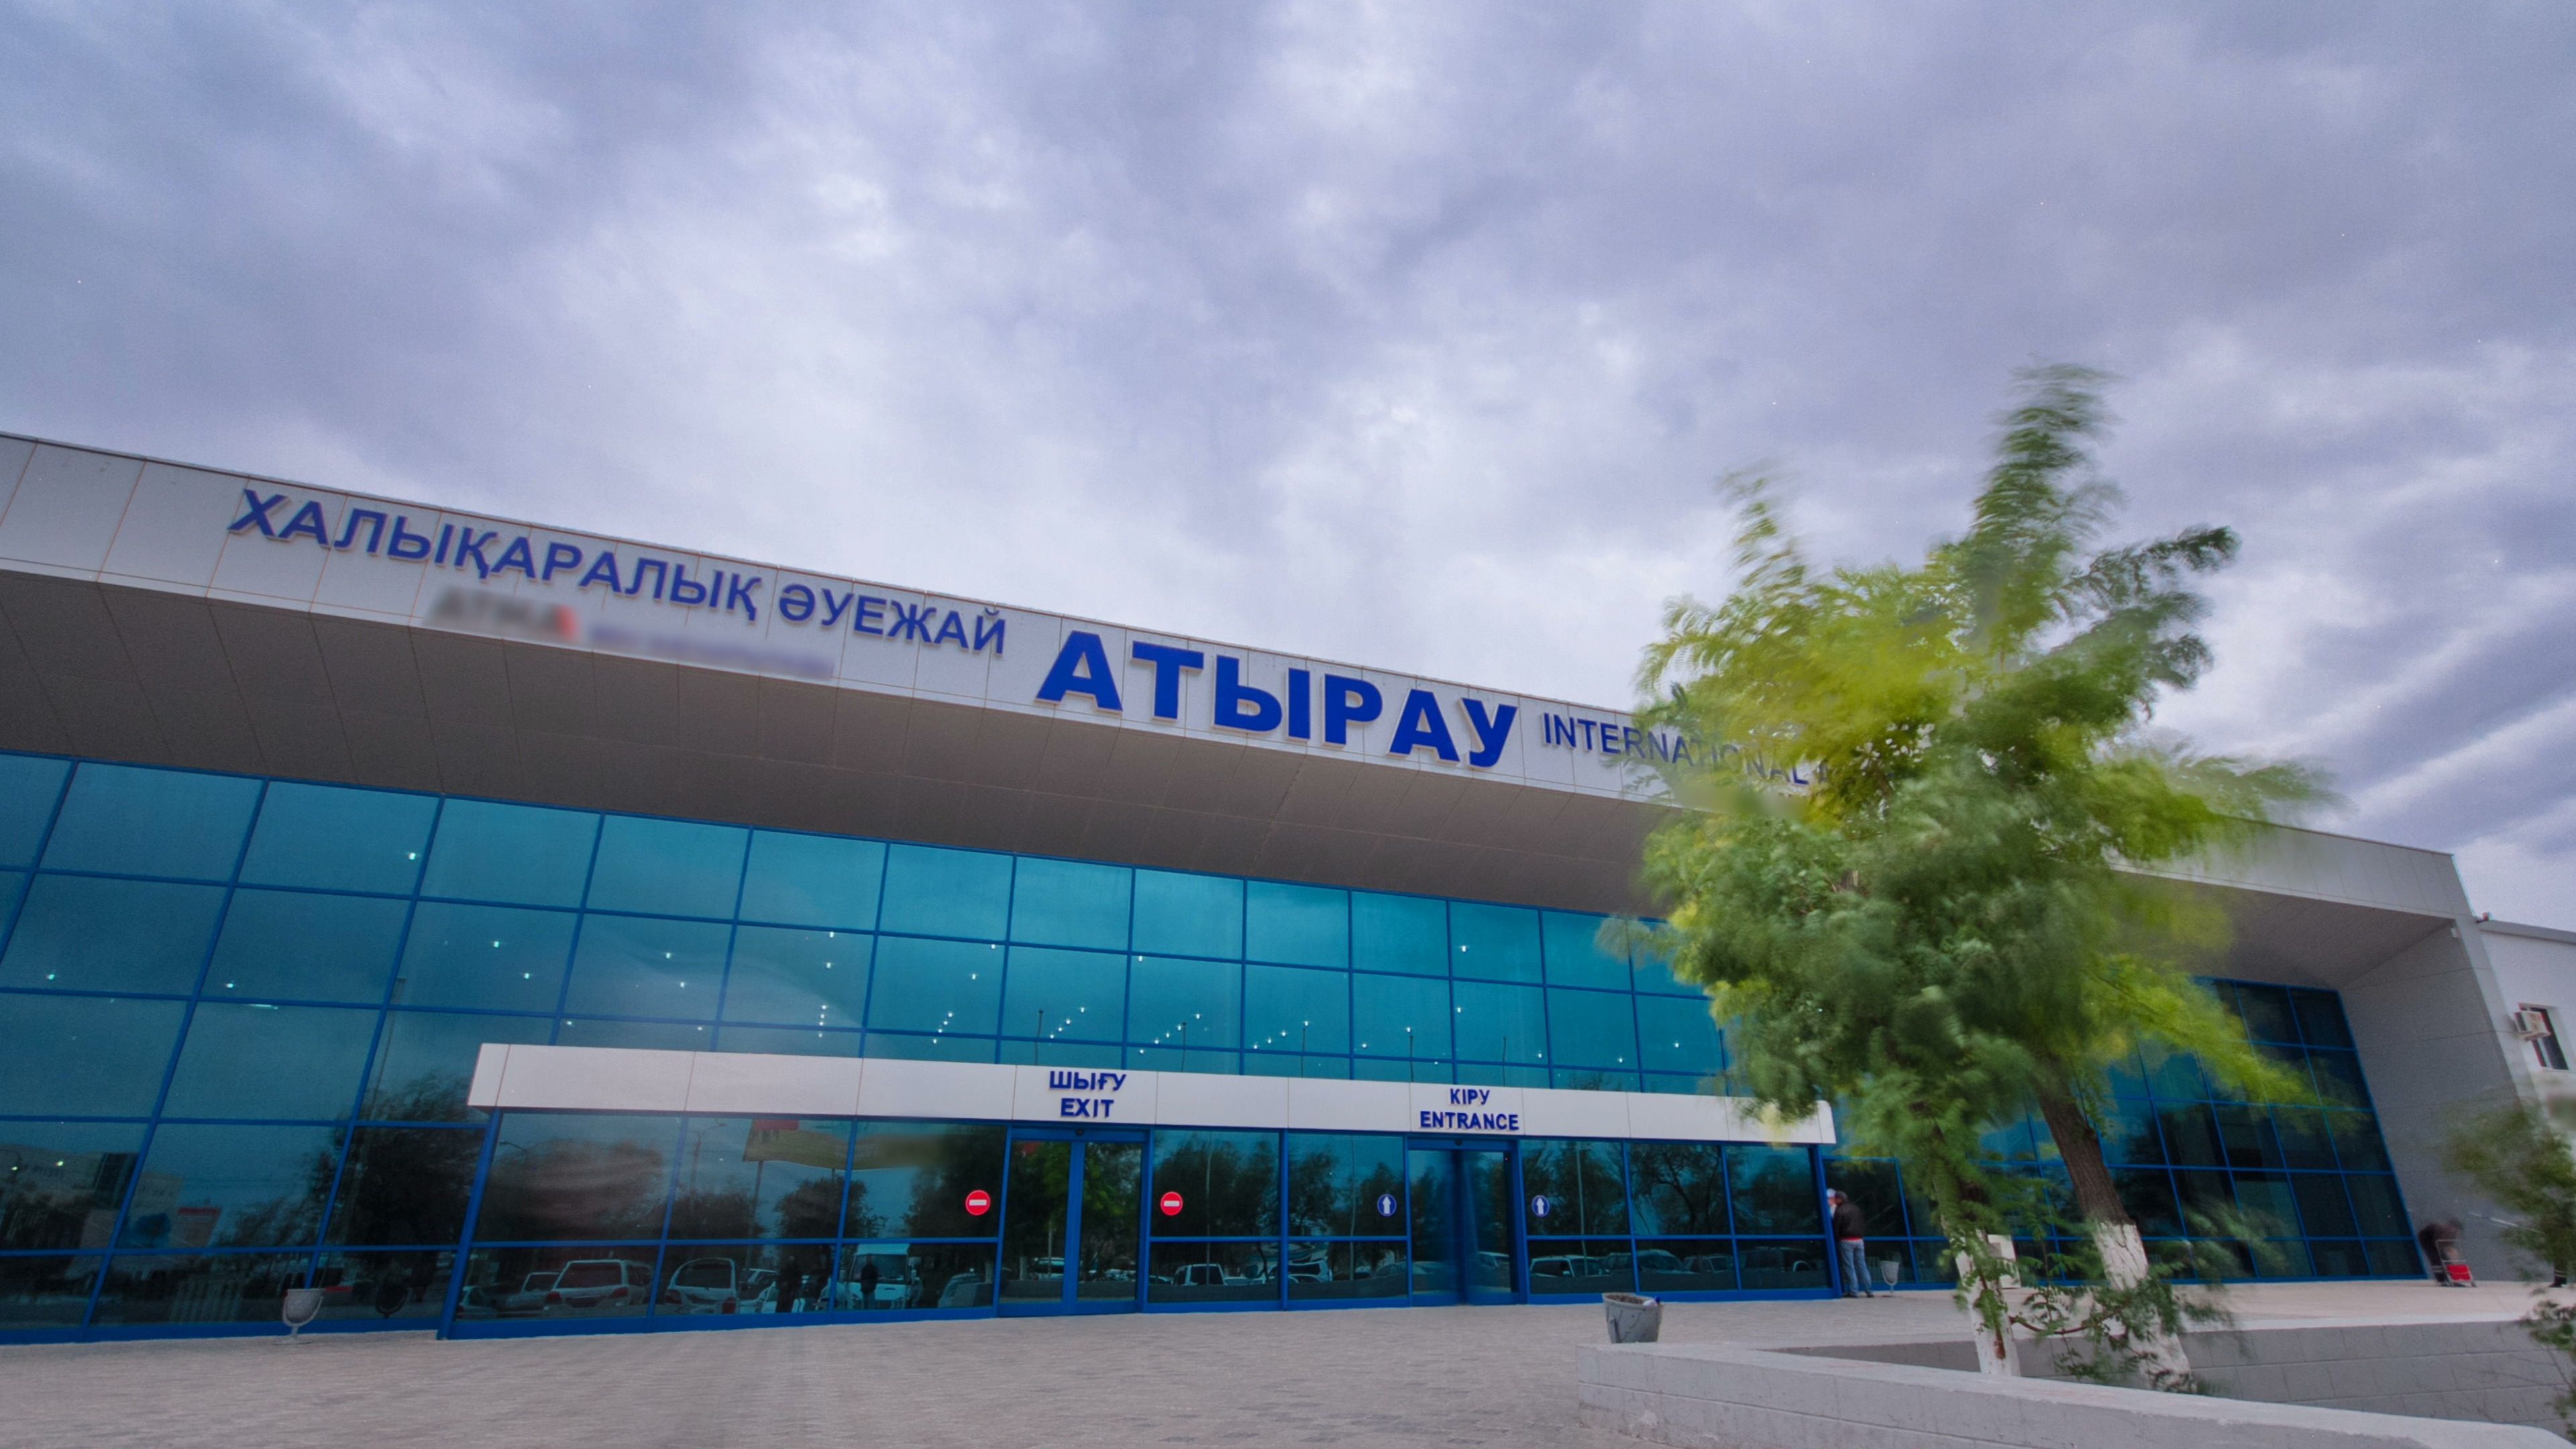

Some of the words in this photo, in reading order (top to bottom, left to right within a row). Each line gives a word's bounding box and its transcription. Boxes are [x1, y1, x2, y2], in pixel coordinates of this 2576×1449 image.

[228, 489, 763, 623] ХАЛЫҚАРАЛЫҚ
[779, 583, 1006, 655] ӘУЕЖАЙ
[1034, 630, 1518, 768] АТЫРАУ
[1049, 1070, 1127, 1091] ШЫҒУ
[1450, 1087, 1491, 1106] КІРУ
[1060, 1097, 1115, 1118] EXIT
[1419, 1110, 1519, 1130] ENTRANCE
